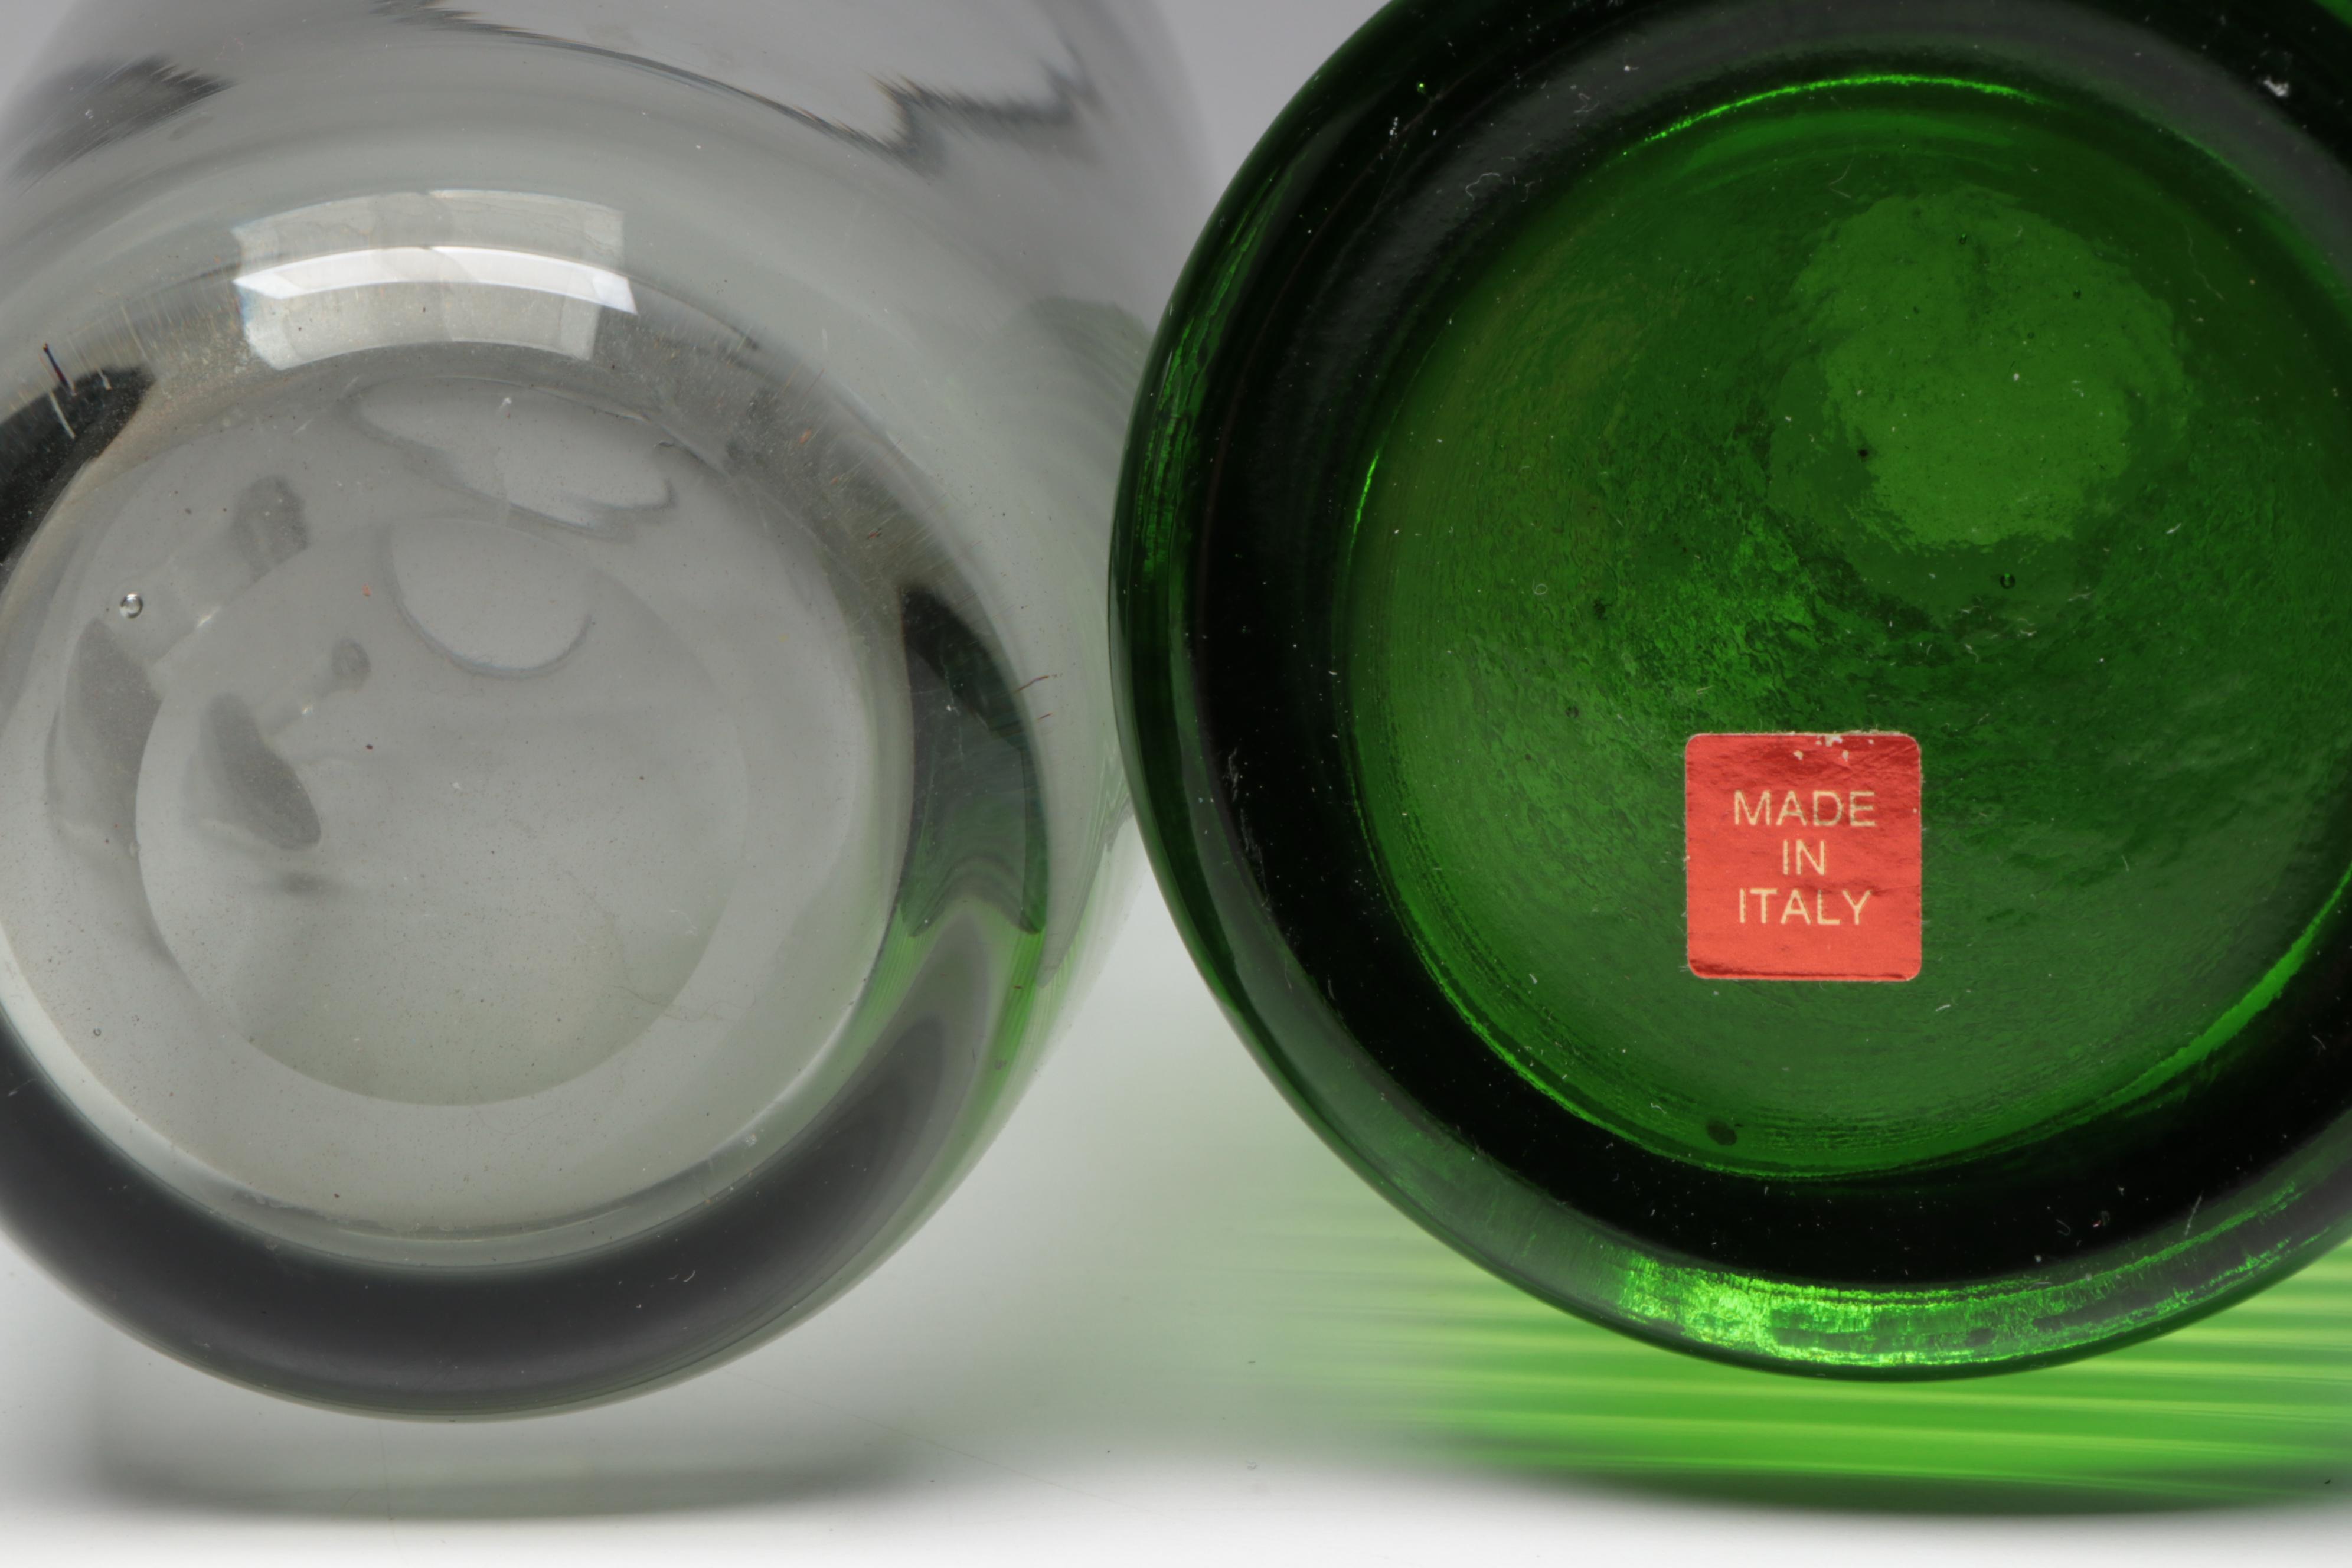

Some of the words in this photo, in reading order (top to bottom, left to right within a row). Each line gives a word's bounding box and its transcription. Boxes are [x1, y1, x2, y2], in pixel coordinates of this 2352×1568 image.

[1734, 790, 1876, 827] MADE
[1782, 839, 1825, 875] IN
[1739, 888, 1871, 925] ITALY
